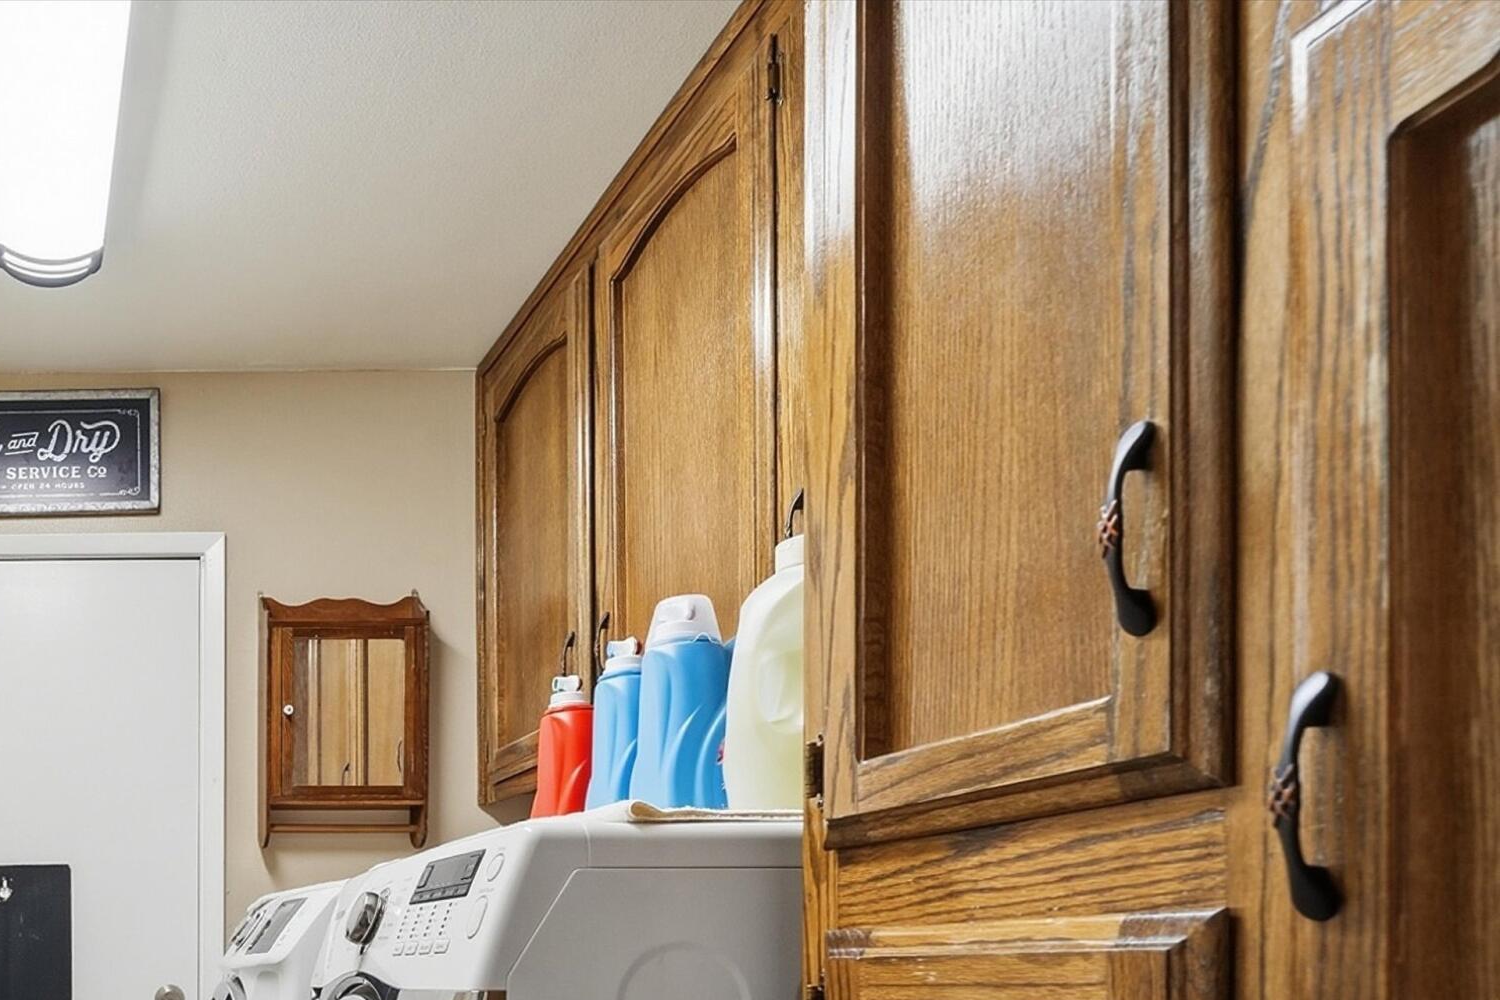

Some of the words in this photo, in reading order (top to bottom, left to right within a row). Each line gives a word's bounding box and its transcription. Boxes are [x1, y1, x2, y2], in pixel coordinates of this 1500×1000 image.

[6, 432, 40, 450] and
[37, 420, 121, 463] Dry
[6, 465, 82, 481] SERVICE
